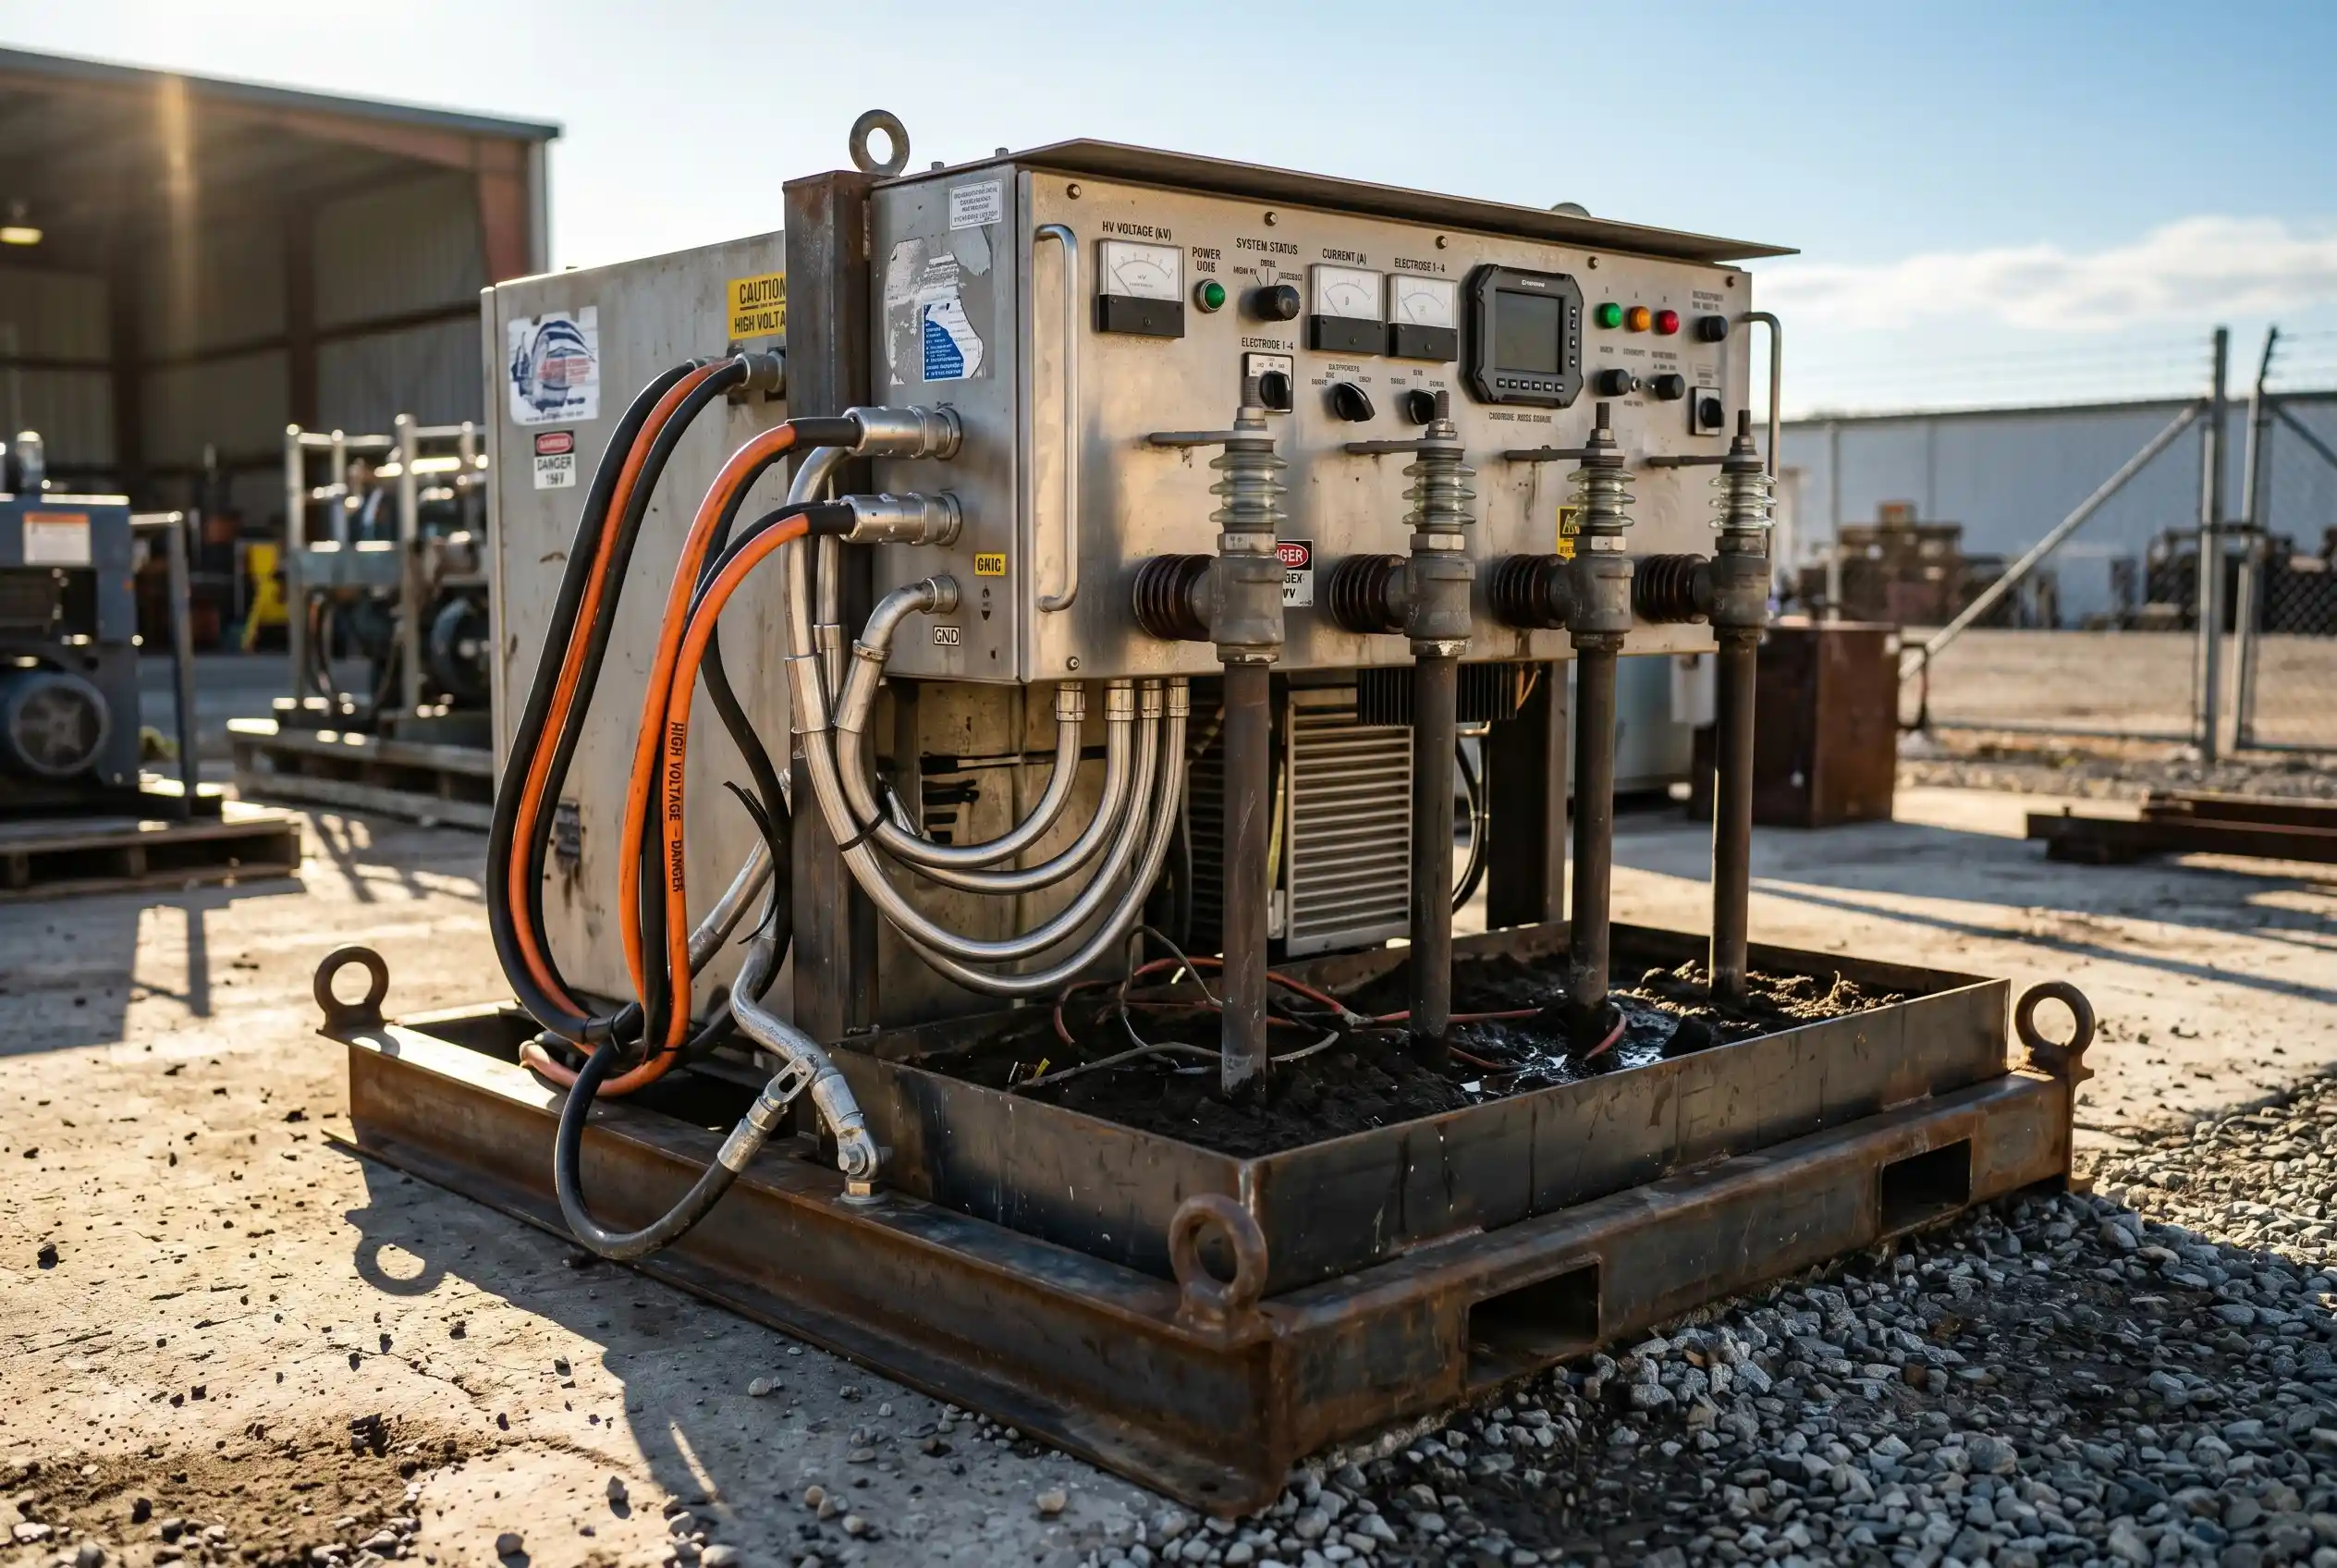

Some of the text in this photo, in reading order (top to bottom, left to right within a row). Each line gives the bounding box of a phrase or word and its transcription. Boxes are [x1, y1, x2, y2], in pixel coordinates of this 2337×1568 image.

[1102, 220, 1115, 233] HV
[1117, 222, 1154, 238] VOLTAGE
[1192, 246, 1221, 260] POWER
[1236, 238, 1298, 255] SYSTEM STATUS
[1322, 248, 1367, 265] CURRENT (A)
[740, 277, 786, 304] CAUTION
[734, 310, 786, 334] HIGH VOLTA
[935, 628, 959, 643] GND
[670, 721, 685, 756] HIGH
[668, 762, 681, 821] VOLTAGE
[671, 839, 685, 892] DANGER
